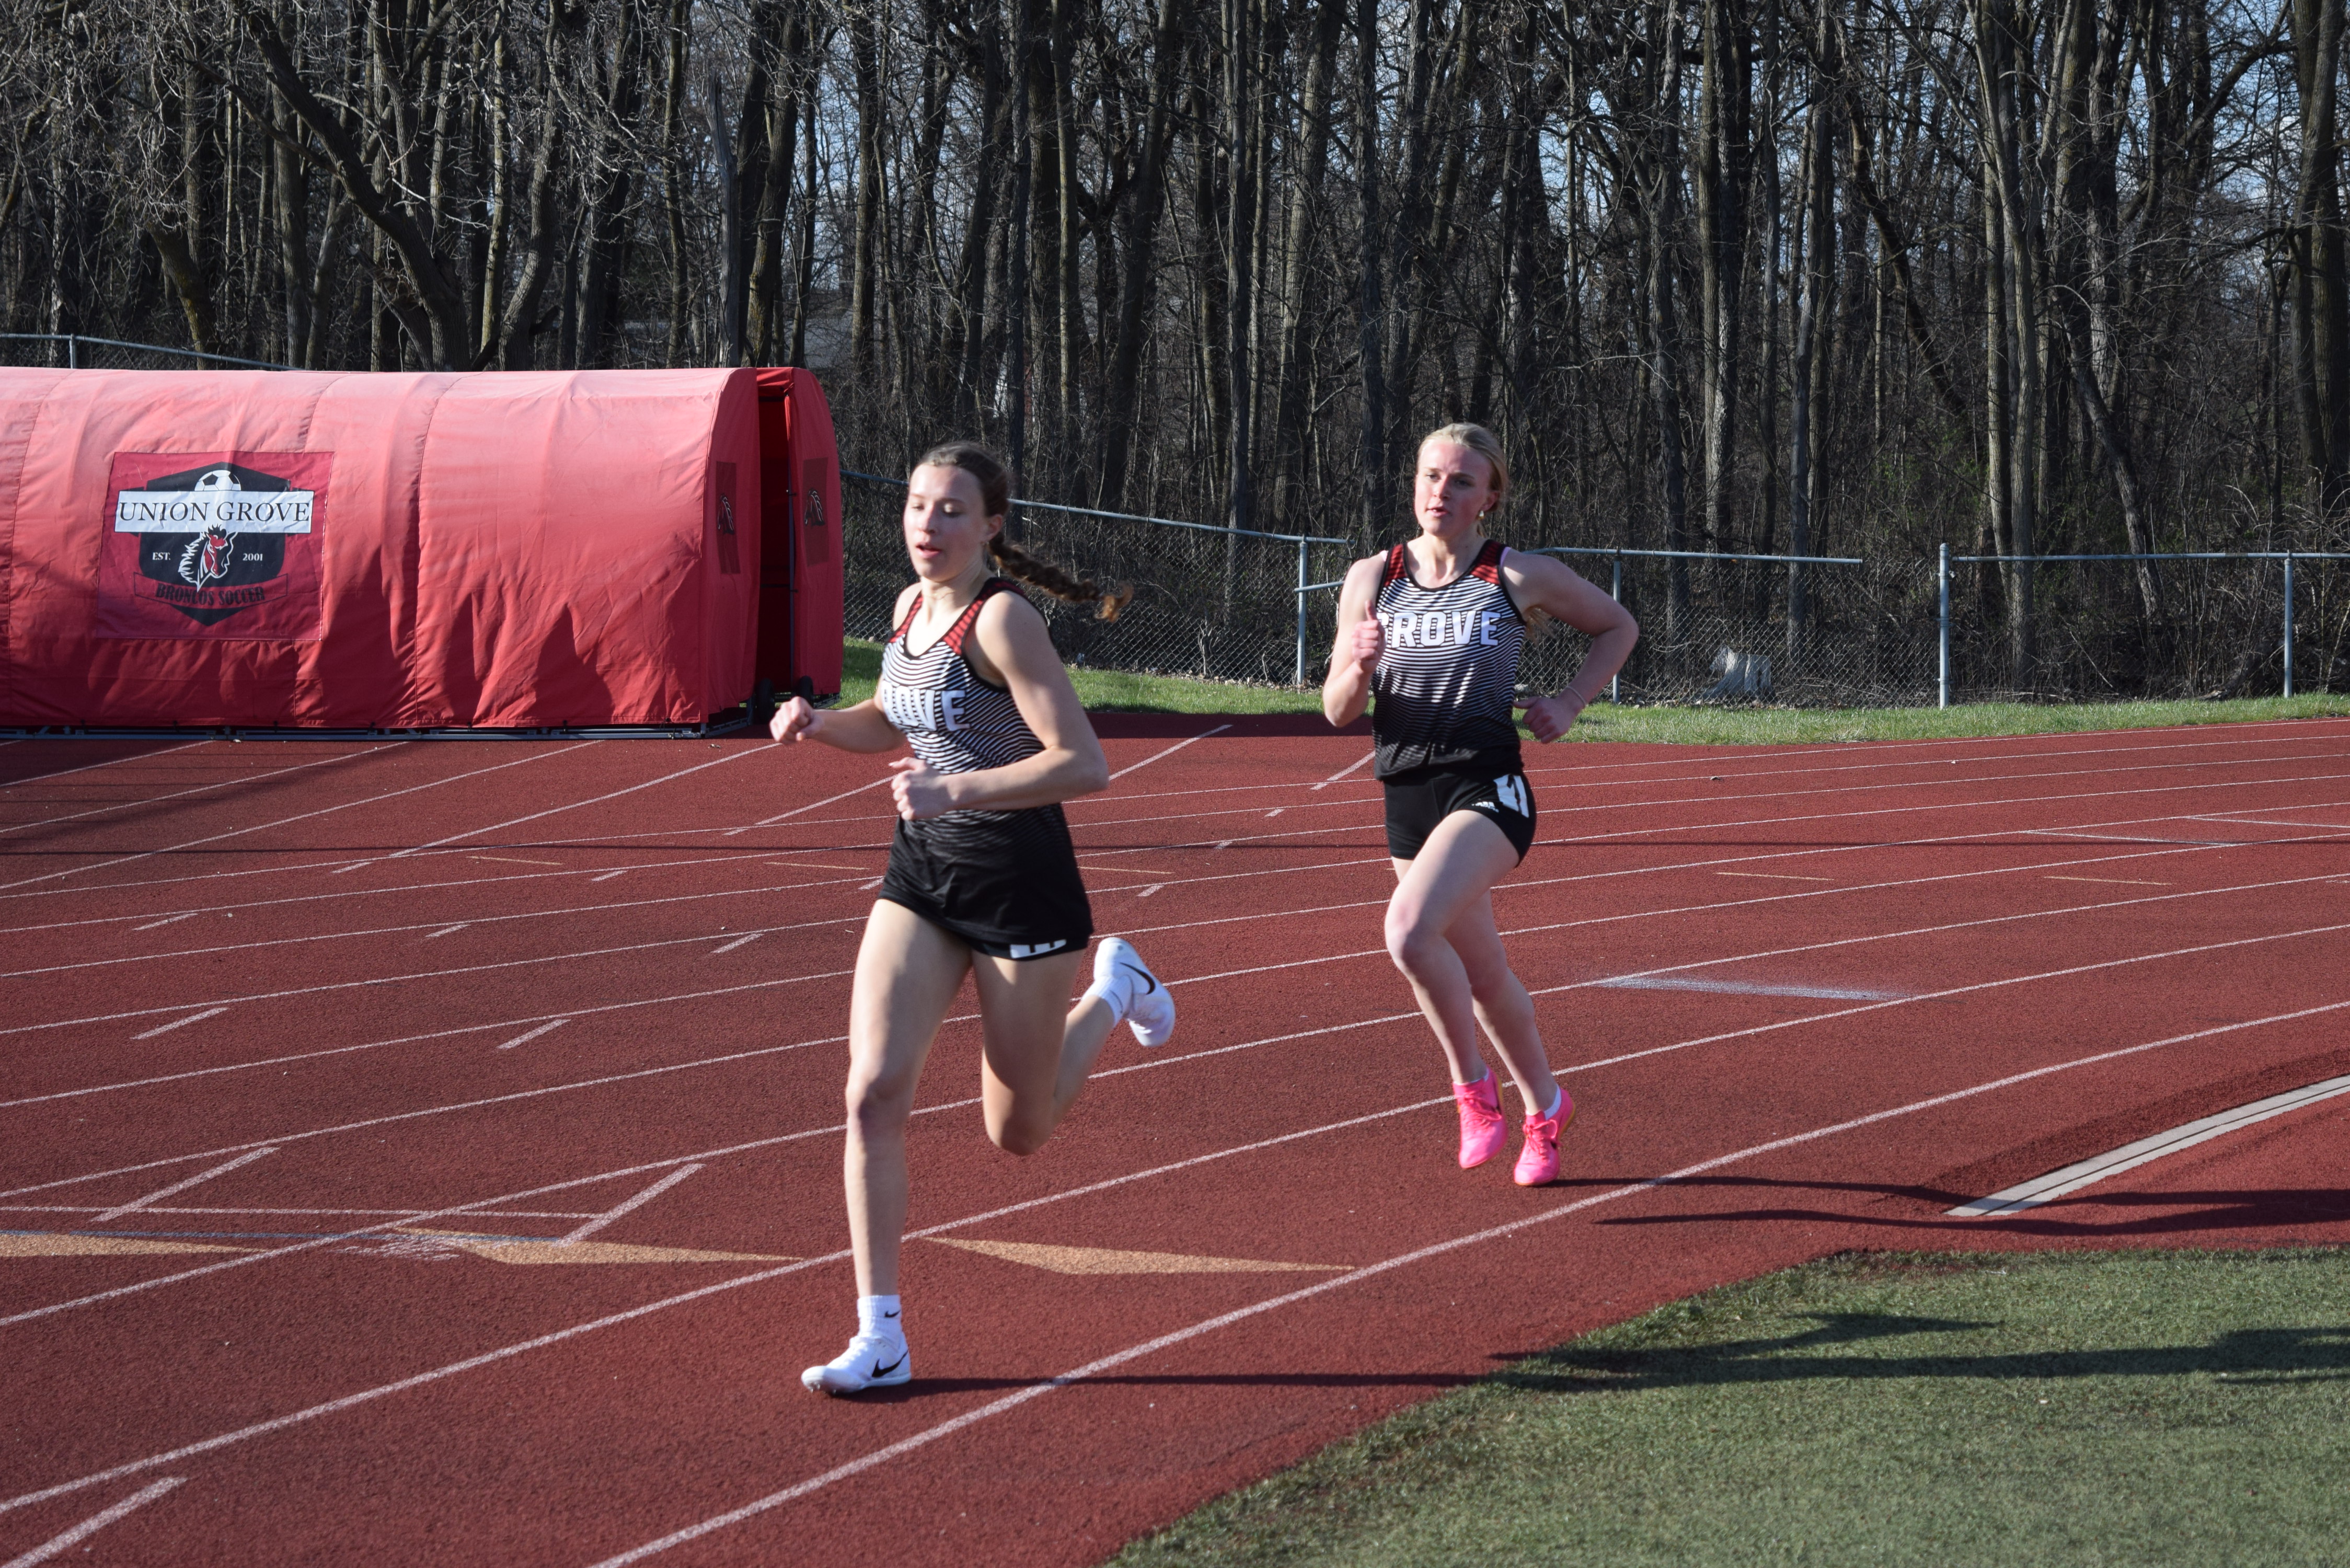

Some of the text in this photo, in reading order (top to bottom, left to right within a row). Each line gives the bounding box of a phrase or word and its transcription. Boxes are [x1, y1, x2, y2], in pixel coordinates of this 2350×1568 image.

[119, 502, 310, 522] UNION GROVE
[152, 551, 263, 561] EST. 2001
[155, 583, 266, 606] BRONCOS SOCCER
